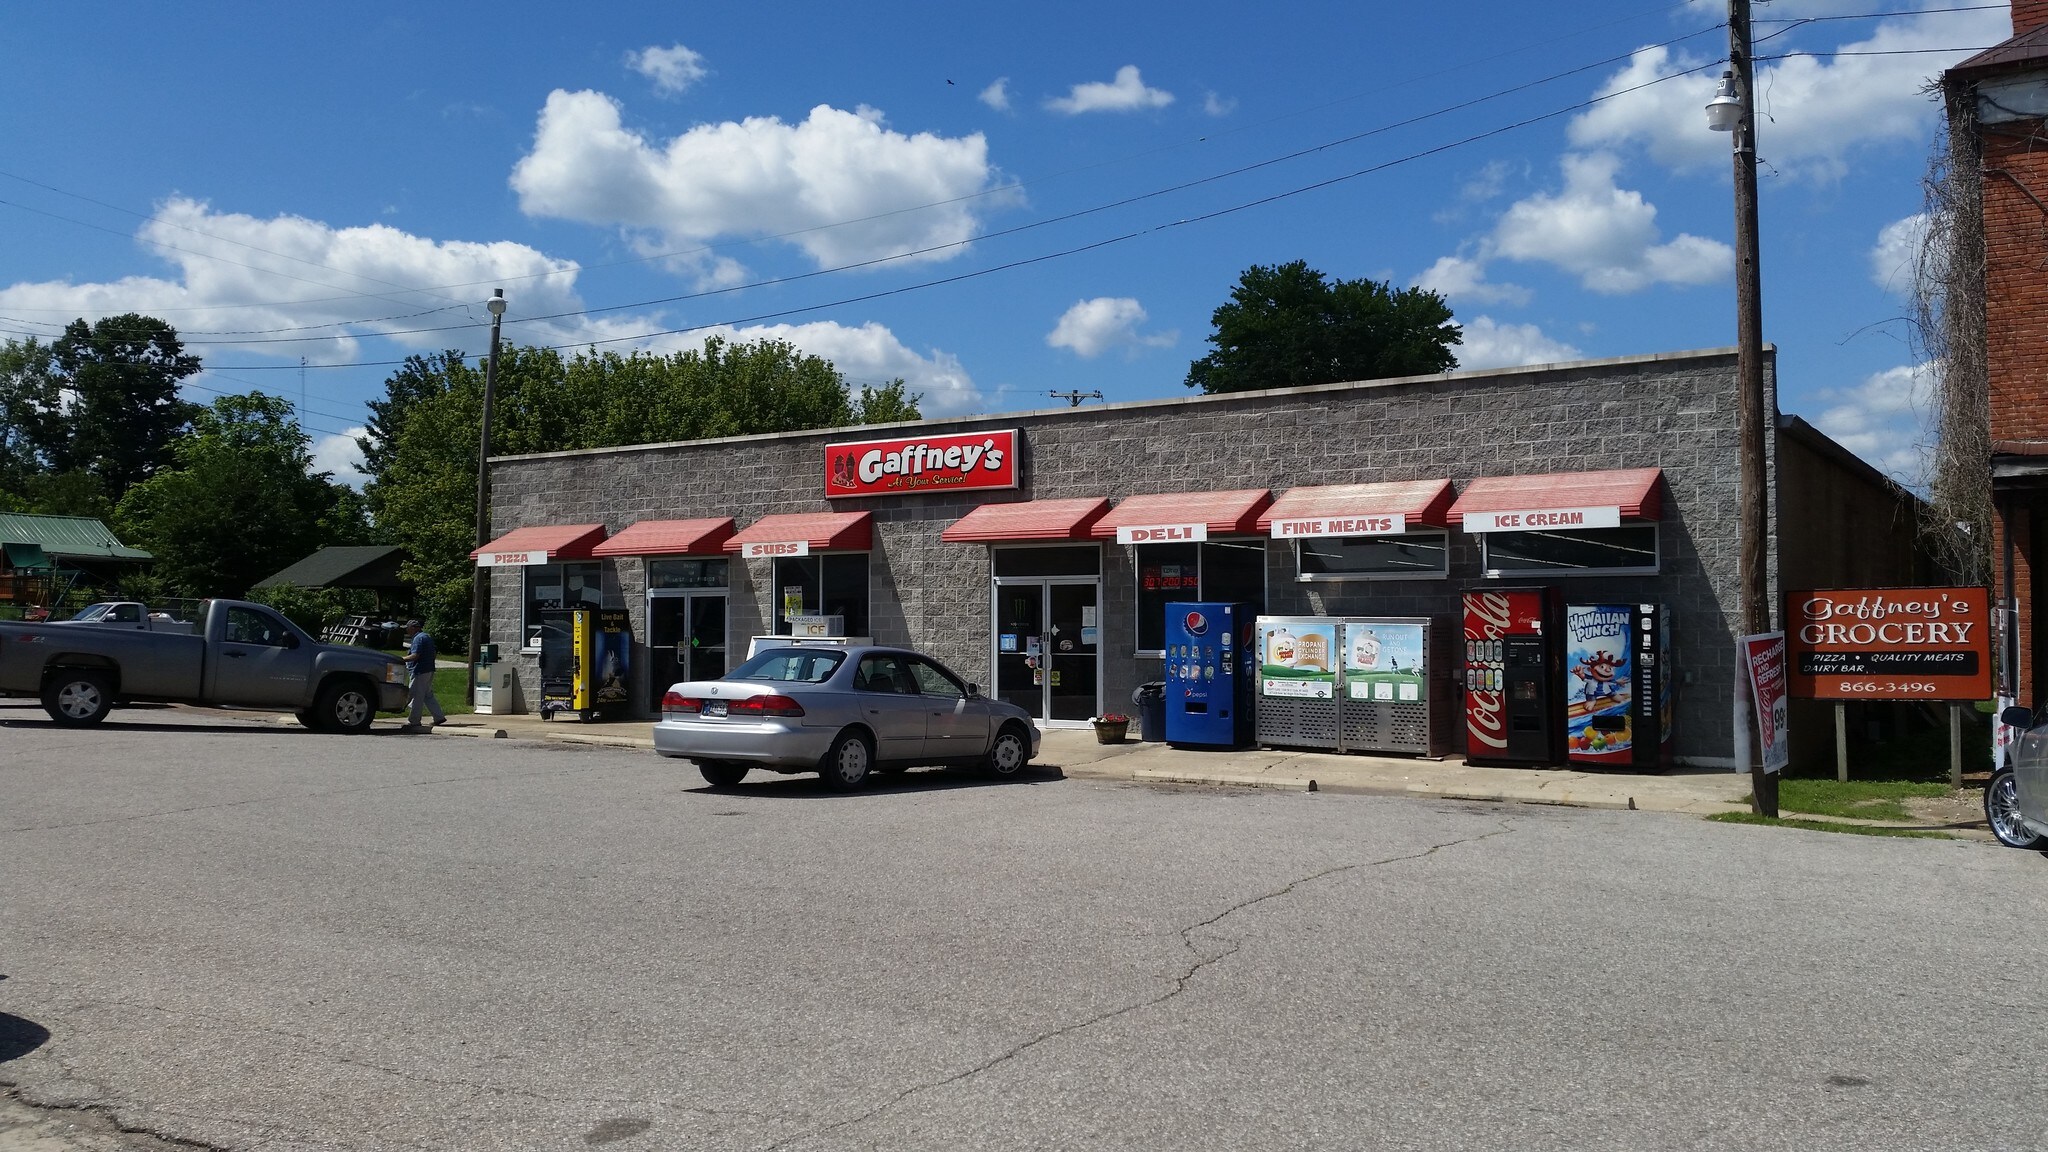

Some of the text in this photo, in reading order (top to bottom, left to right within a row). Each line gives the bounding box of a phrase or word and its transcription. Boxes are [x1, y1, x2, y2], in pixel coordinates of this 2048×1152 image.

[858, 438, 1003, 483] Gaffney's
[888, 473, 967, 488] At Your Service!
[1282, 518, 1392, 535] FINE MEATS
[1495, 512, 1584, 528] ICE CREAM
[1131, 527, 1192, 541] DELI
[751, 543, 798, 556] SUBS
[495, 553, 529, 564] PIZZA
[1802, 594, 1969, 620] Gaffney's
[1569, 611, 1630, 631] HAWAIIAN
[807, 625, 825, 635] ICE
[1576, 623, 1621, 642] PUNCH
[1800, 622, 1974, 645] GROCERY
[1298, 653, 1326, 661] EXCHANGE
[1752, 640, 1784, 667] RECHARGE
[1812, 653, 1965, 663] PIZZA QUALITY MEATS
[1757, 662, 1770, 676] AND
[1758, 666, 1781, 686] REFRESH
[1804, 664, 1864, 673] DAIRY BAR
[1840, 681, 1937, 693] 866-3496
